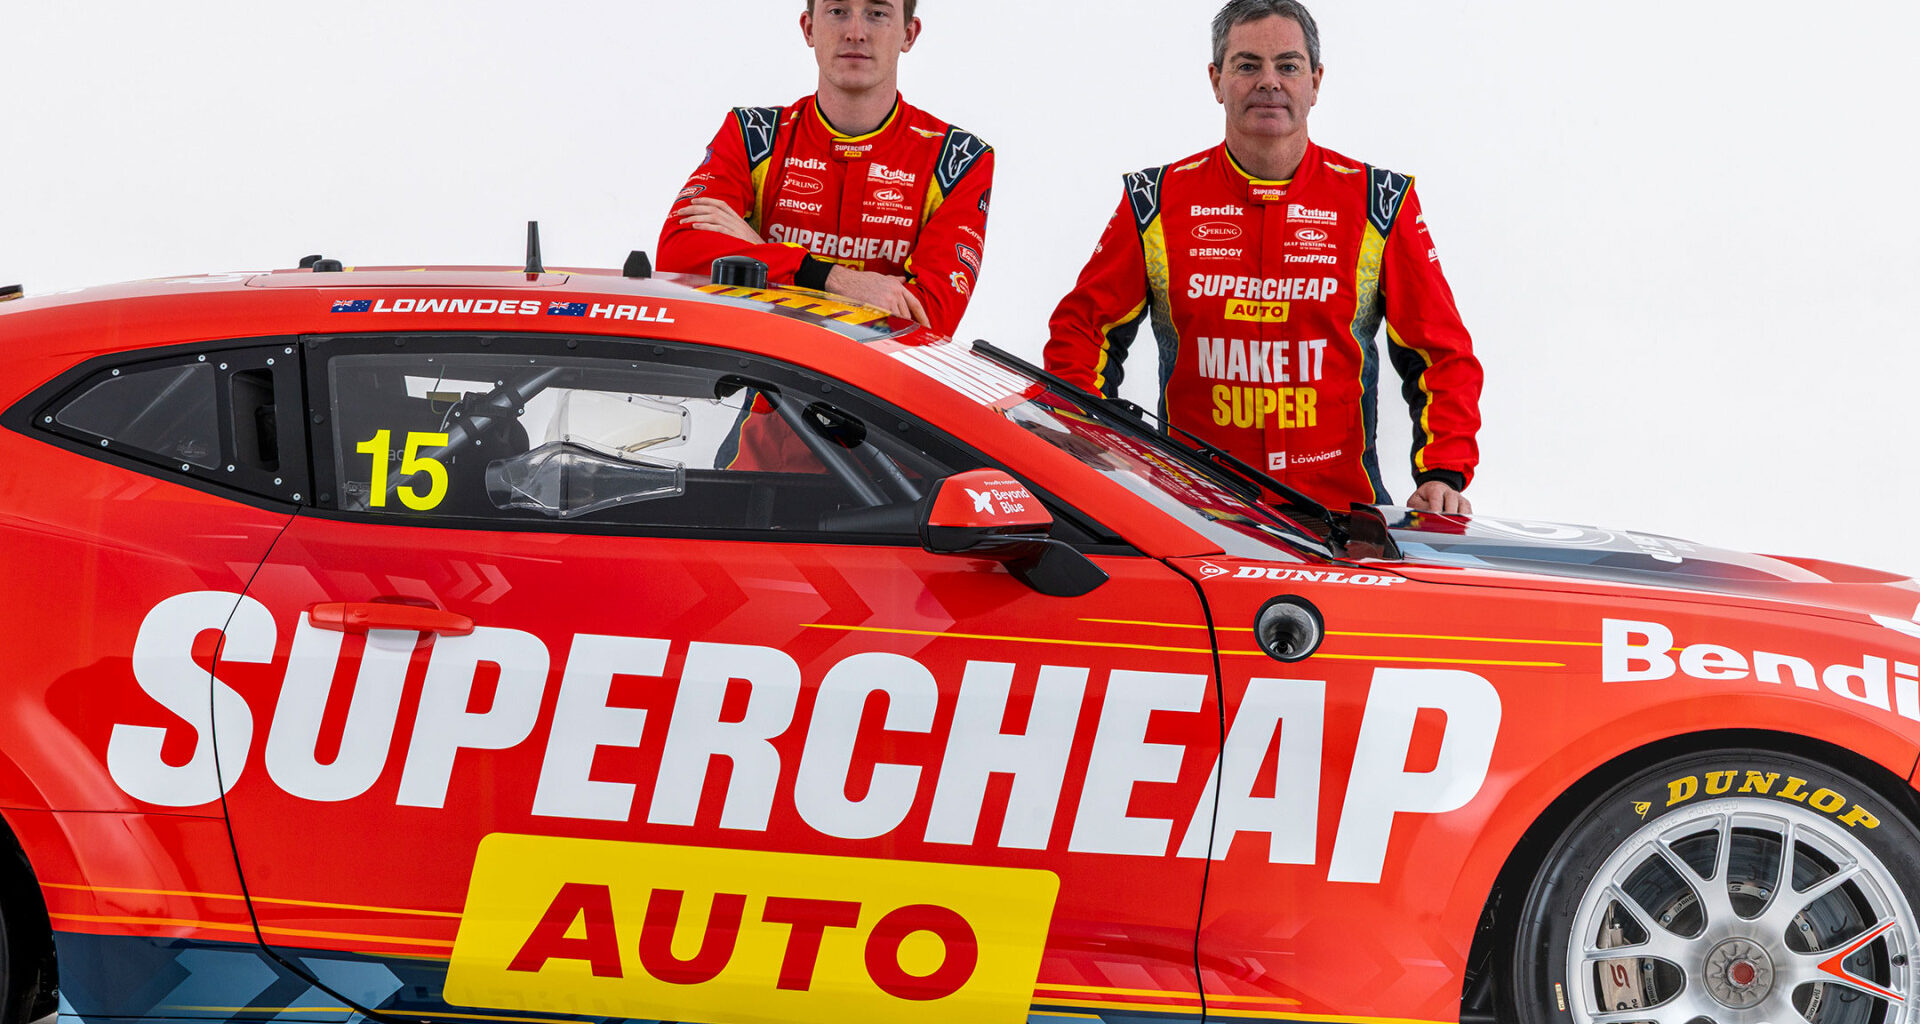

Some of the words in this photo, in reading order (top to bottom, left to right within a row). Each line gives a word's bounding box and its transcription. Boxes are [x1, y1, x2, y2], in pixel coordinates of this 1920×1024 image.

[779, 199, 823, 213] RENOGY
[1190, 204, 1244, 217] Bendix
[1287, 204, 1337, 221] Century
[861, 213, 914, 228] ToolPRO
[1198, 226, 1238, 238] SPERLING
[1198, 248, 1243, 257] RENOGY
[1283, 254, 1338, 265] ToolPRO
[1186, 273, 1339, 303] SUPERCHEAP
[372, 298, 541, 316] LOWNDES
[589, 303, 676, 324] HALL
[1232, 304, 1284, 318] AUTO
[1197, 336, 1290, 384] MAKE
[1298, 338, 1328, 383] IT
[1212, 384, 1318, 430] SUPER
[1291, 449, 1343, 464] LOWNDES
[356, 428, 449, 511] 15
[991, 487, 1030, 502] Beyond
[1000, 501, 1025, 514] Blue
[1232, 565, 1408, 588] DUNLOP
[107, 591, 1503, 883] SUPERCHEAP
[1666, 769, 1879, 830] DUNLOP
[507, 882, 979, 1001] AUTO
